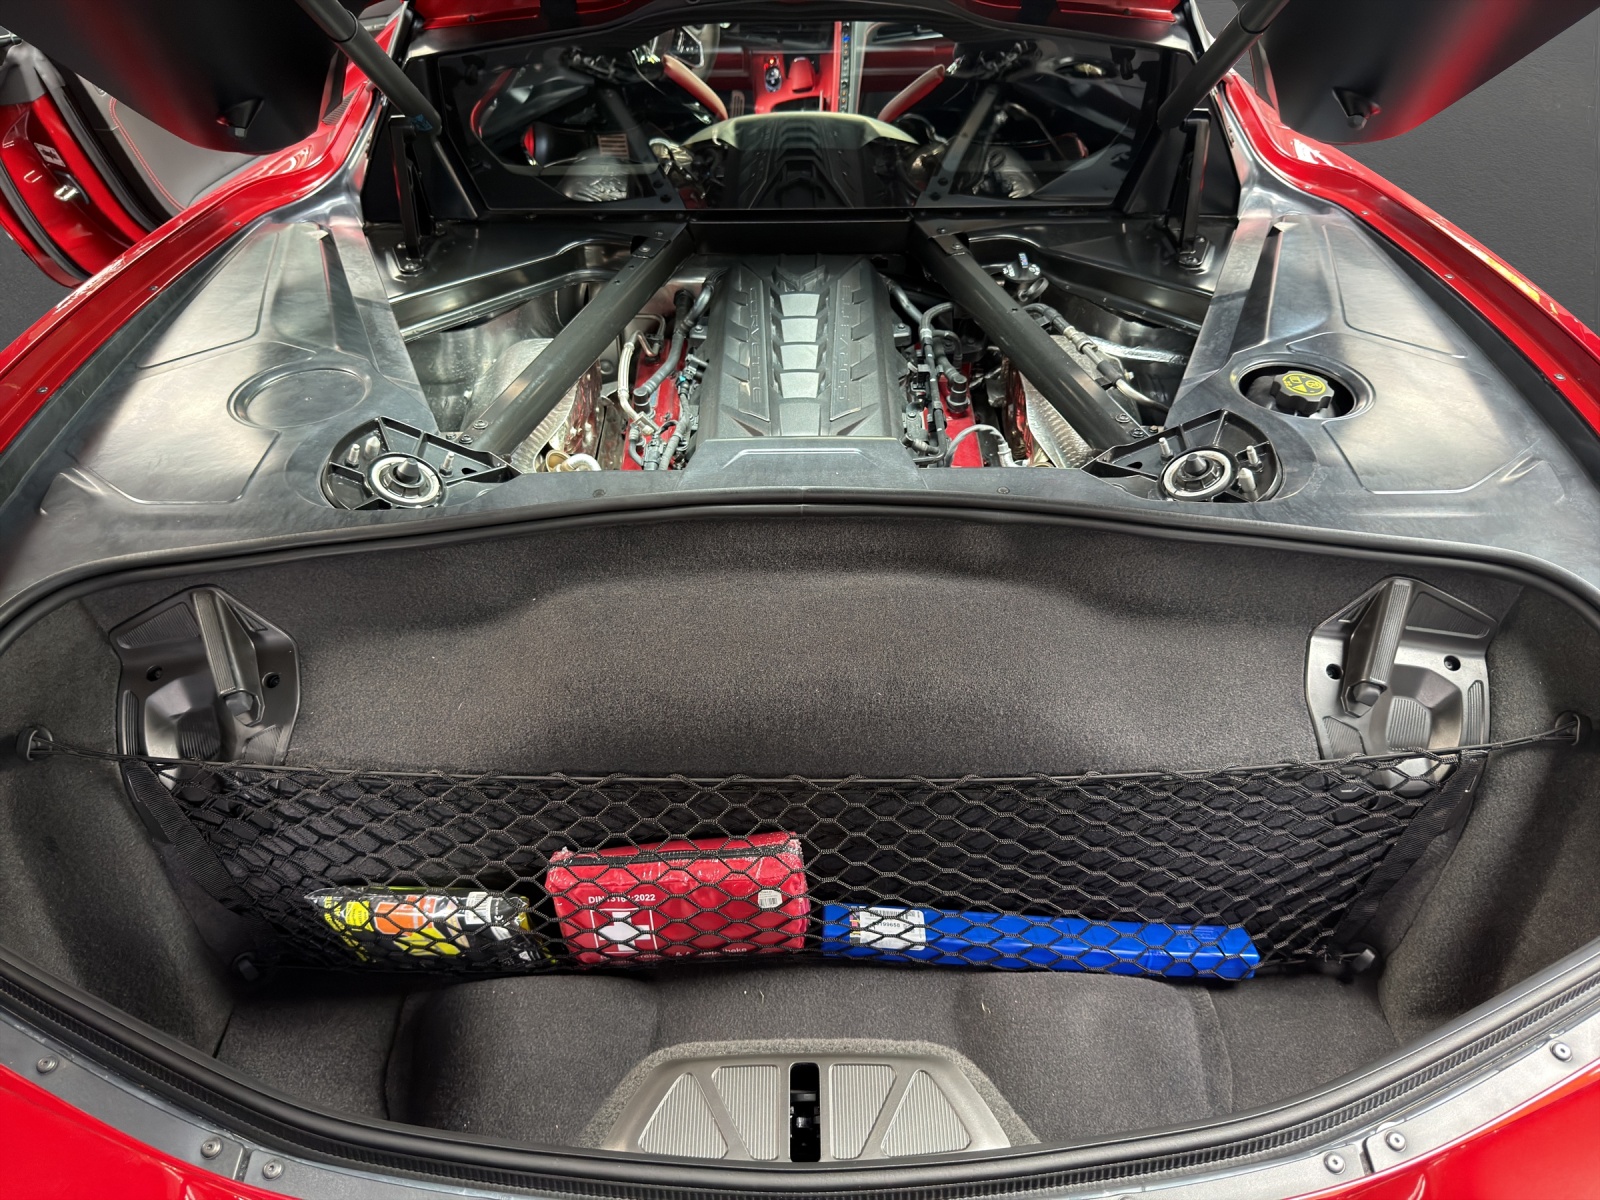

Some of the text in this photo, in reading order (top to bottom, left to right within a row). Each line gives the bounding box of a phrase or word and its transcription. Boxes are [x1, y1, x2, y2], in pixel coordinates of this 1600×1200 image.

[749, 287, 762, 403] CORVETTE
[836, 285, 851, 401] CORVETTE
[588, 896, 604, 904] DIN
